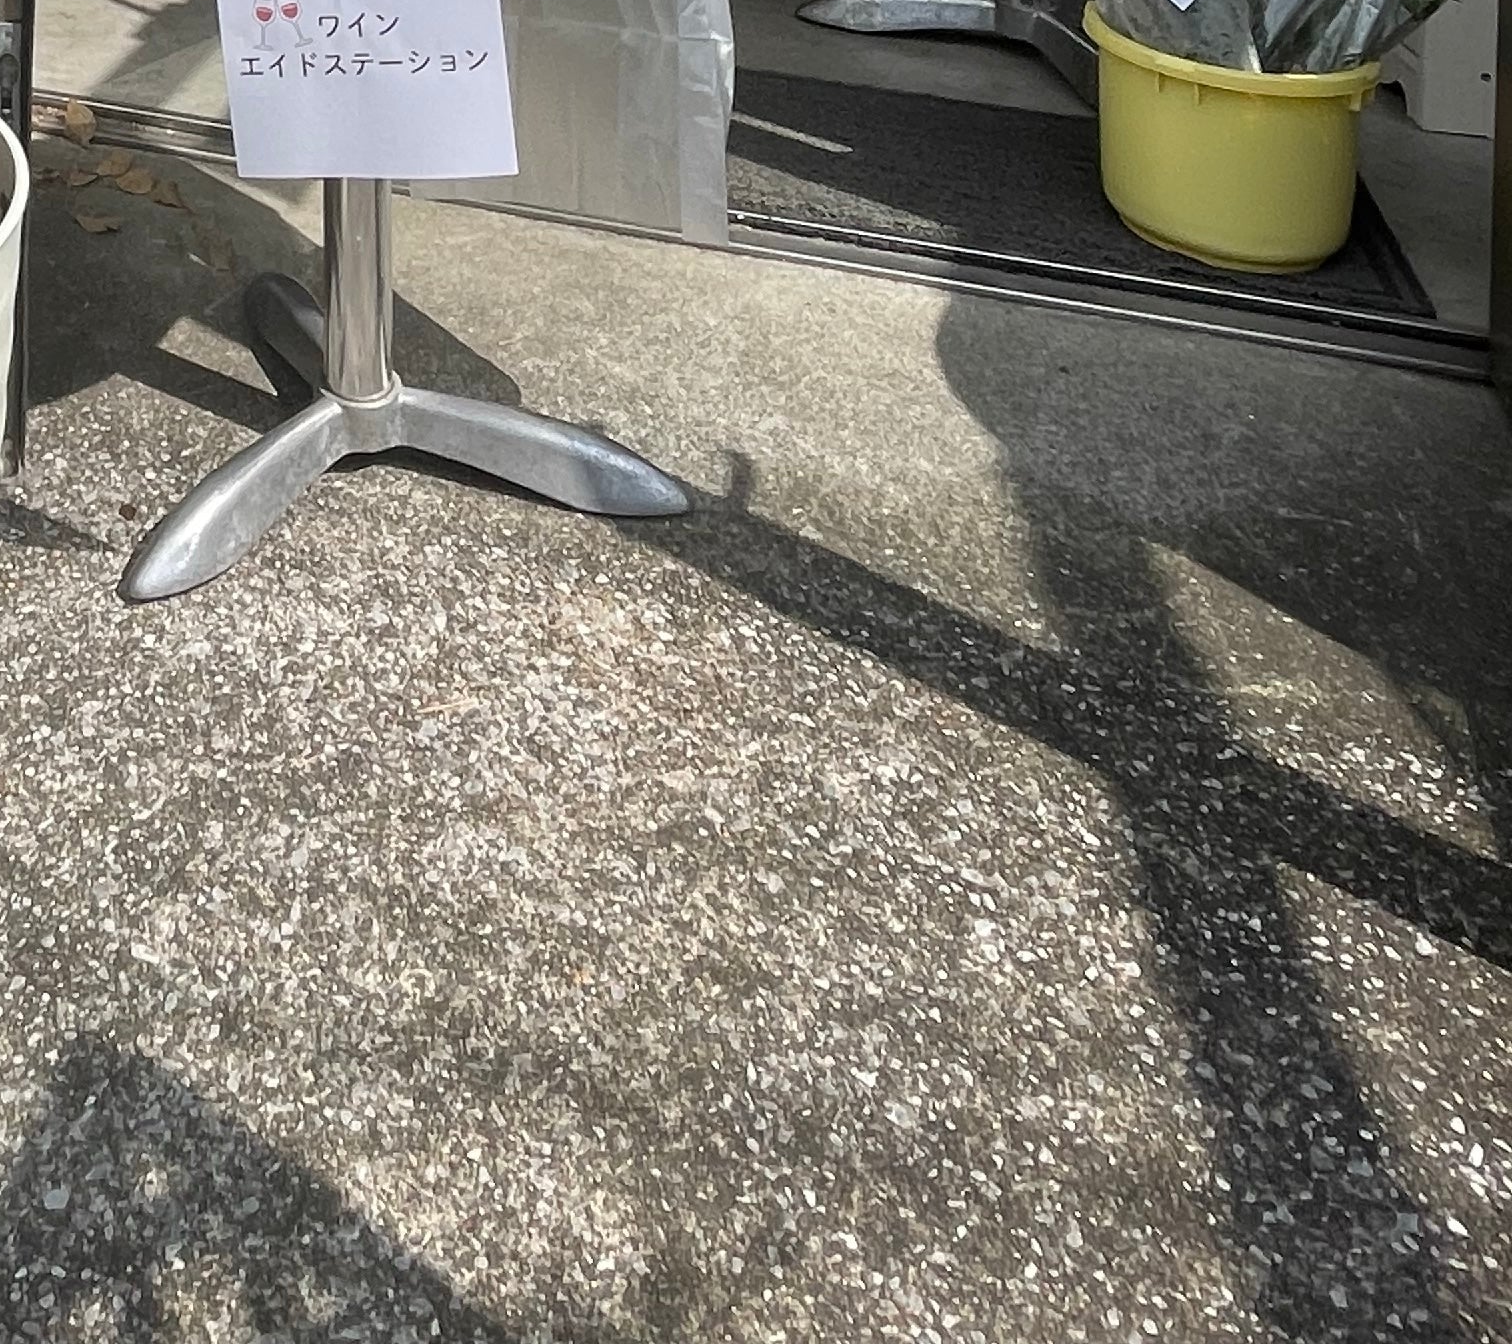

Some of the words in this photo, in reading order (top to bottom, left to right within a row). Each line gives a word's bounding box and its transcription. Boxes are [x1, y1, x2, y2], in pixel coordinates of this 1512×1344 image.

[317, 12, 401, 38] ワイン
[239, 48, 489, 79] エイドステーション
